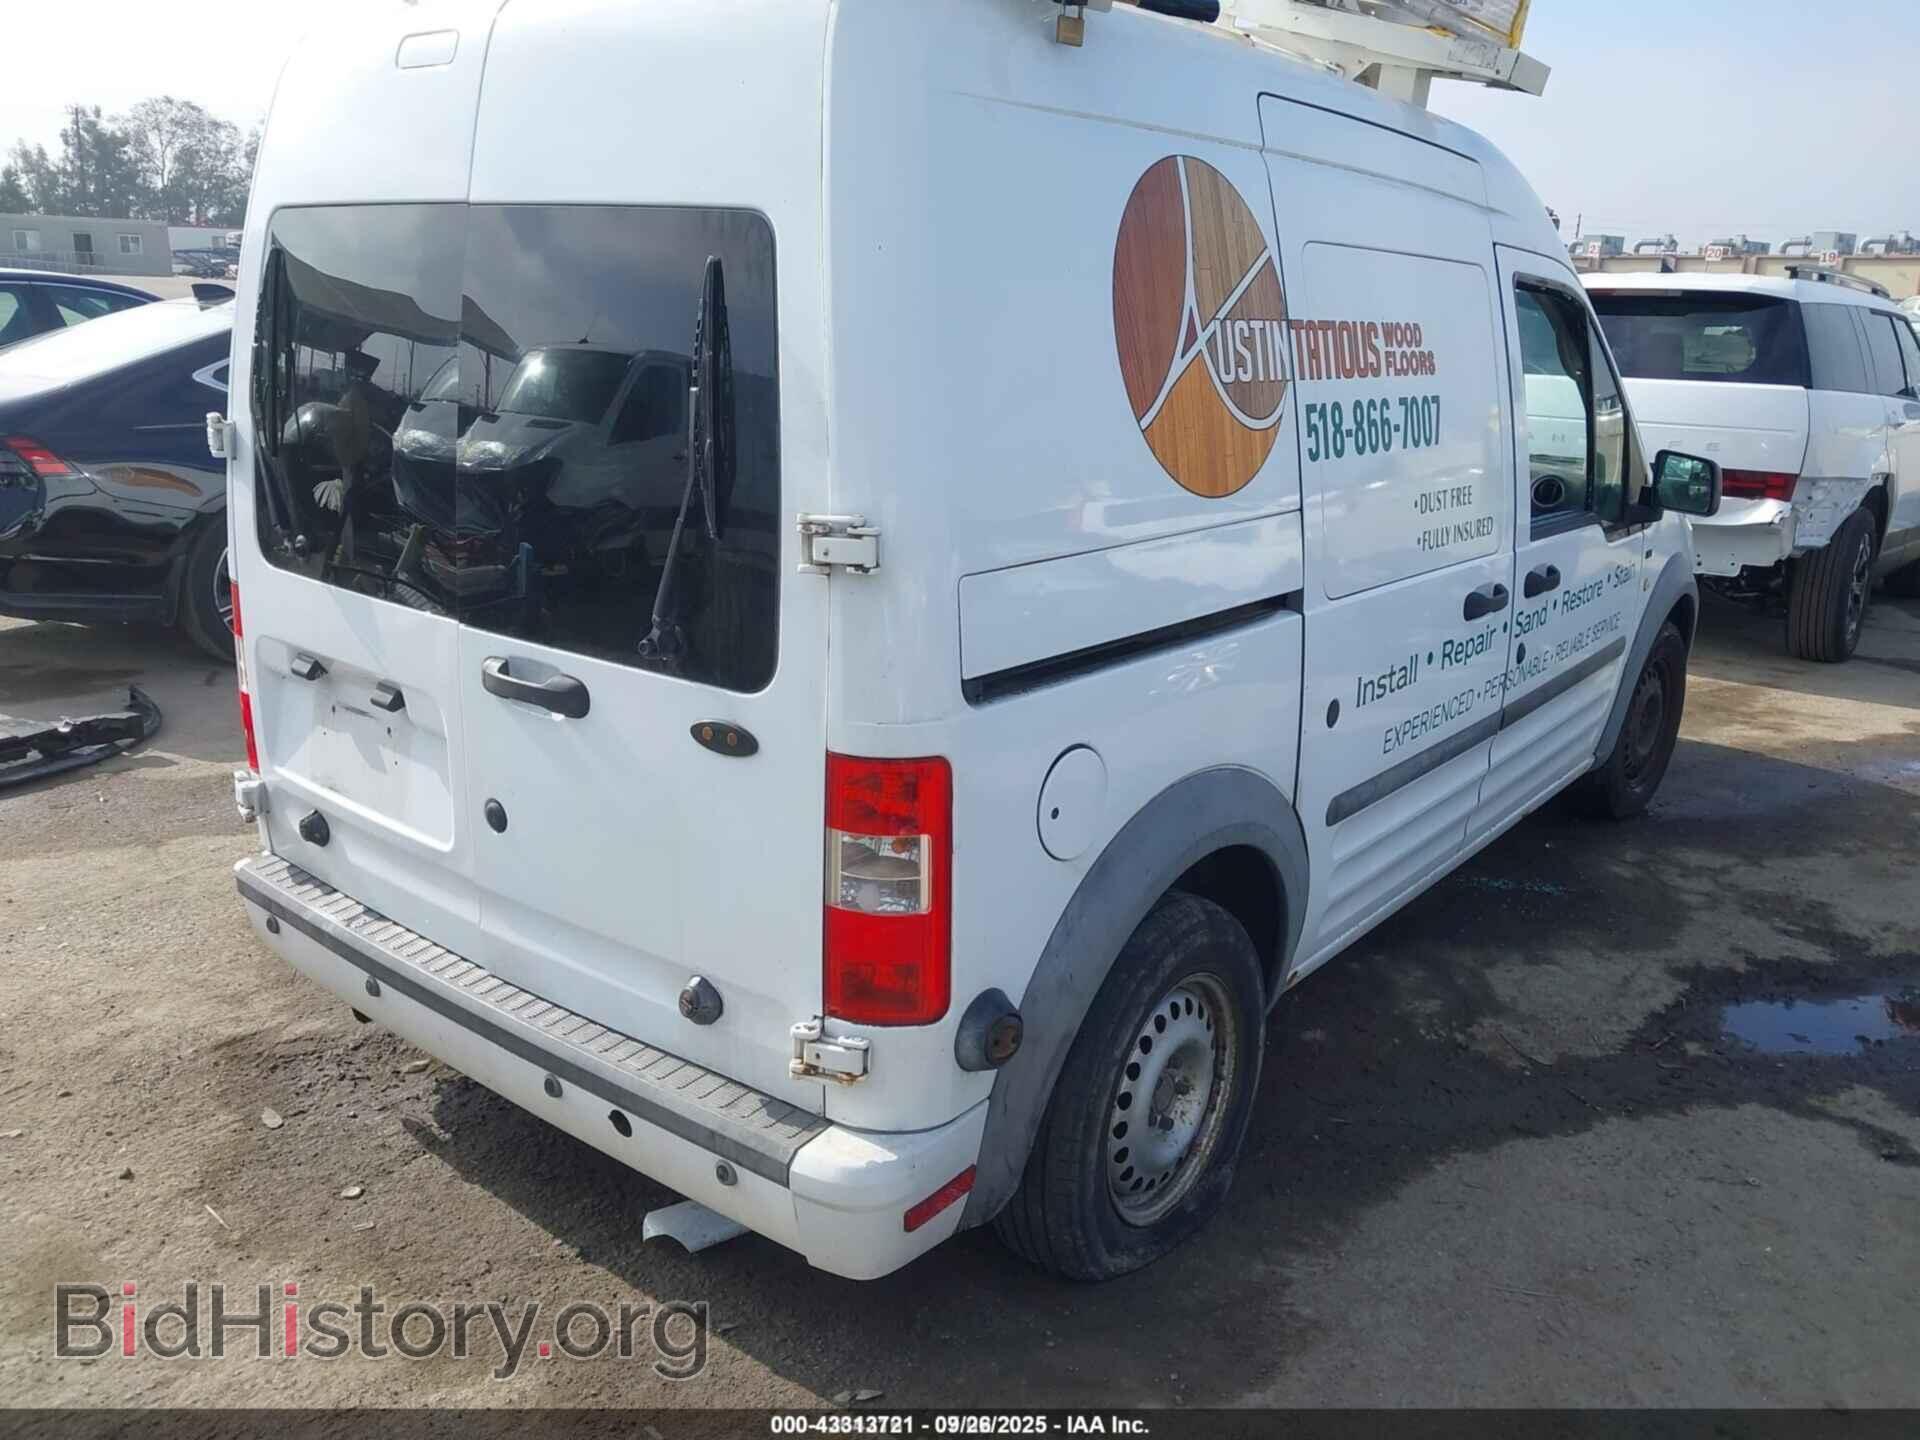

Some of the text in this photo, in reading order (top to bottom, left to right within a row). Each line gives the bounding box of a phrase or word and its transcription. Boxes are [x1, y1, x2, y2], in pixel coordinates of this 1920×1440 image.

[1382, 322, 1422, 348] WOOD
[1384, 350, 1436, 377] FLOORS
[1305, 395, 1440, 462] 518-866-7007
[1420, 484, 1473, 514] DUST FREE
[1422, 516, 1494, 551] FULLY INSURED
[1356, 653, 1419, 708] Install
[1440, 624, 1497, 671] Repair
[1514, 599, 1549, 638] Sand
[1561, 579, 1604, 616] Restore
[1383, 610, 1622, 754] EXPERIENCED PERSONABLE RELIABLE SERVICE
